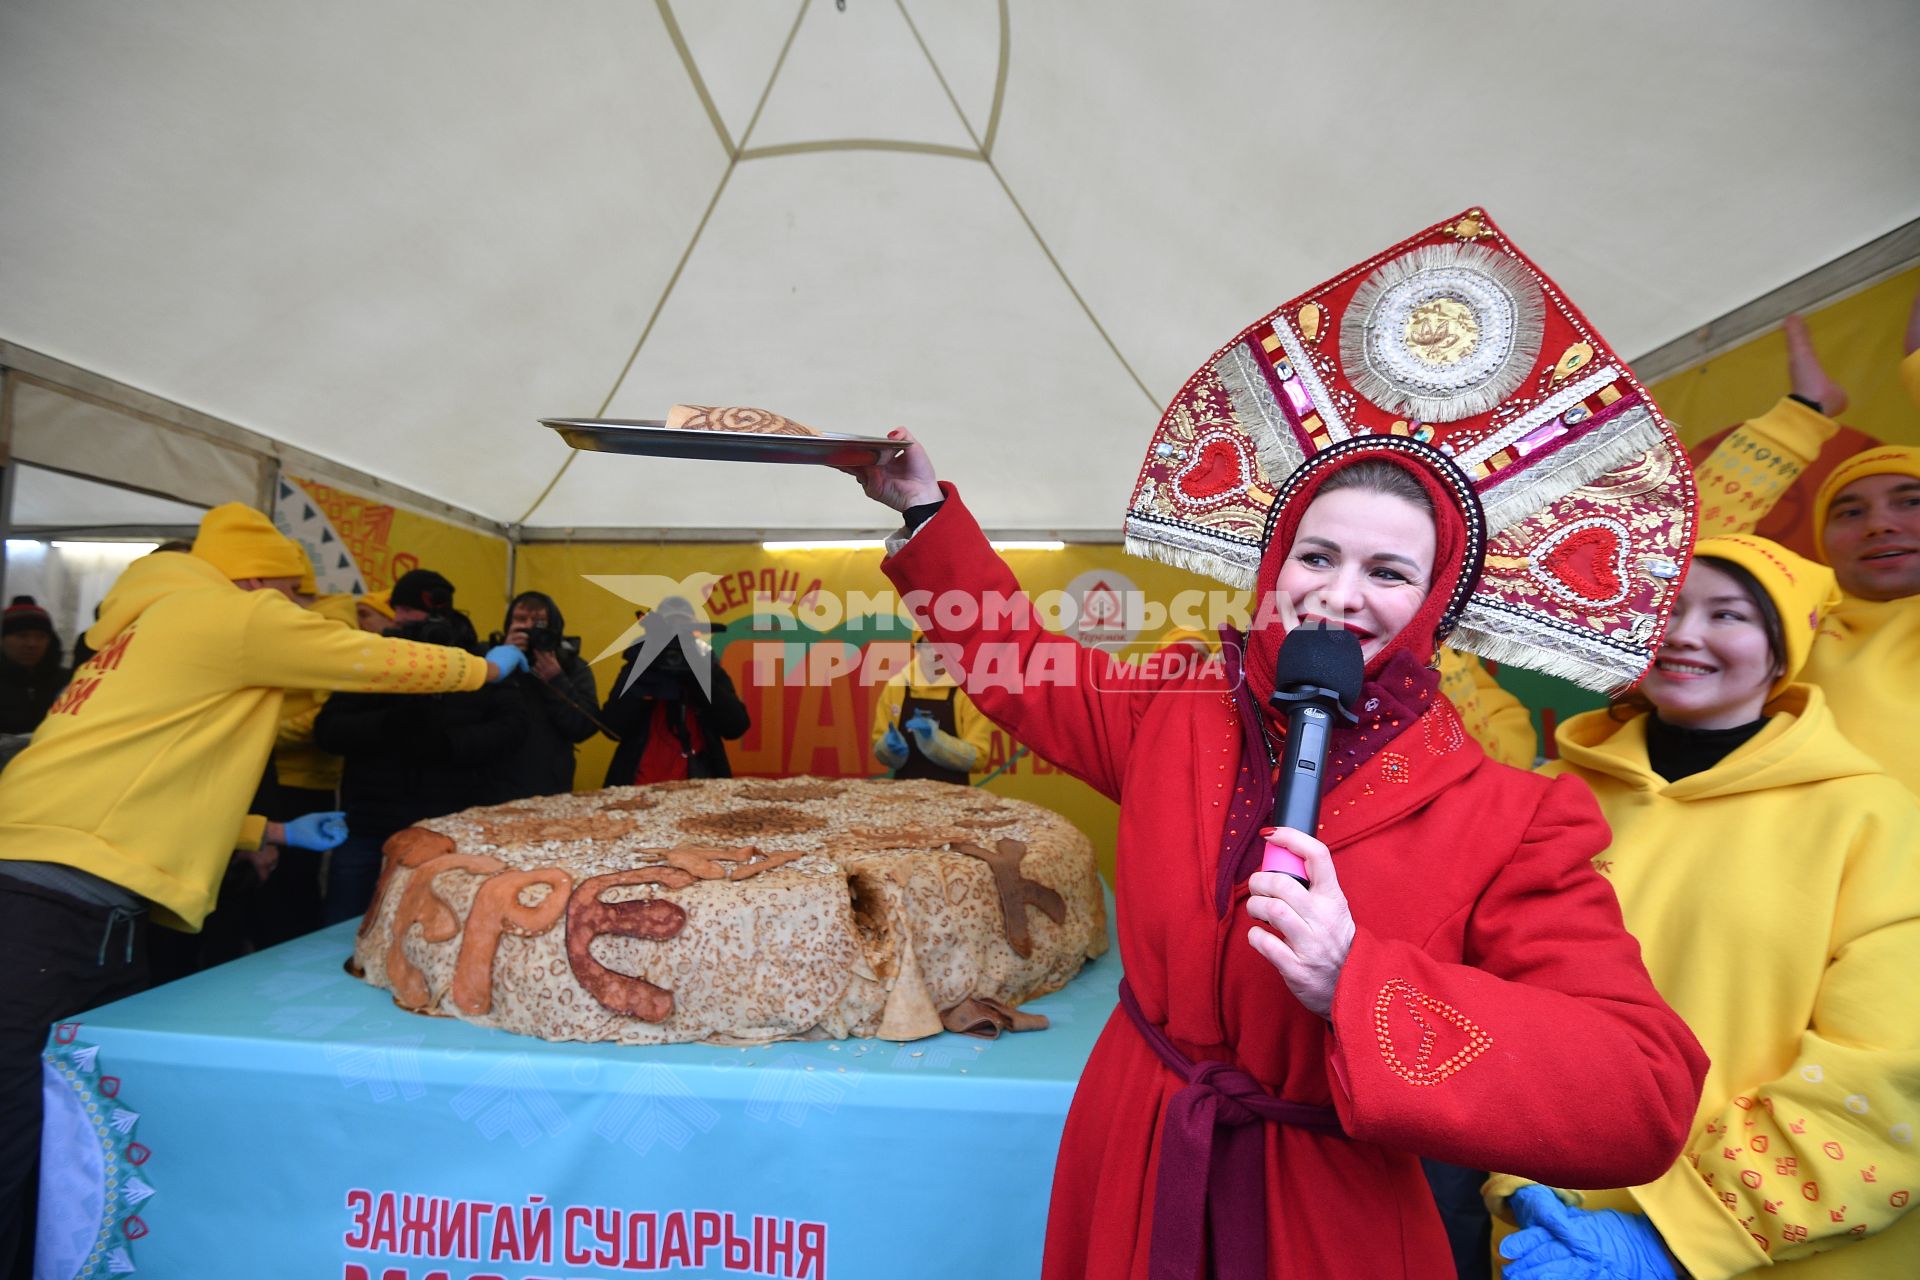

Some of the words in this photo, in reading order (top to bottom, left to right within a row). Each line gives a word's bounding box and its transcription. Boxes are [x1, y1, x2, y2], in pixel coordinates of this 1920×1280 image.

[703, 567, 823, 617] СЕРДЦА
[344, 1188, 552, 1265] ЗАЖИГАЙ
[563, 1206, 826, 1280] СУДАРЫНЯ
